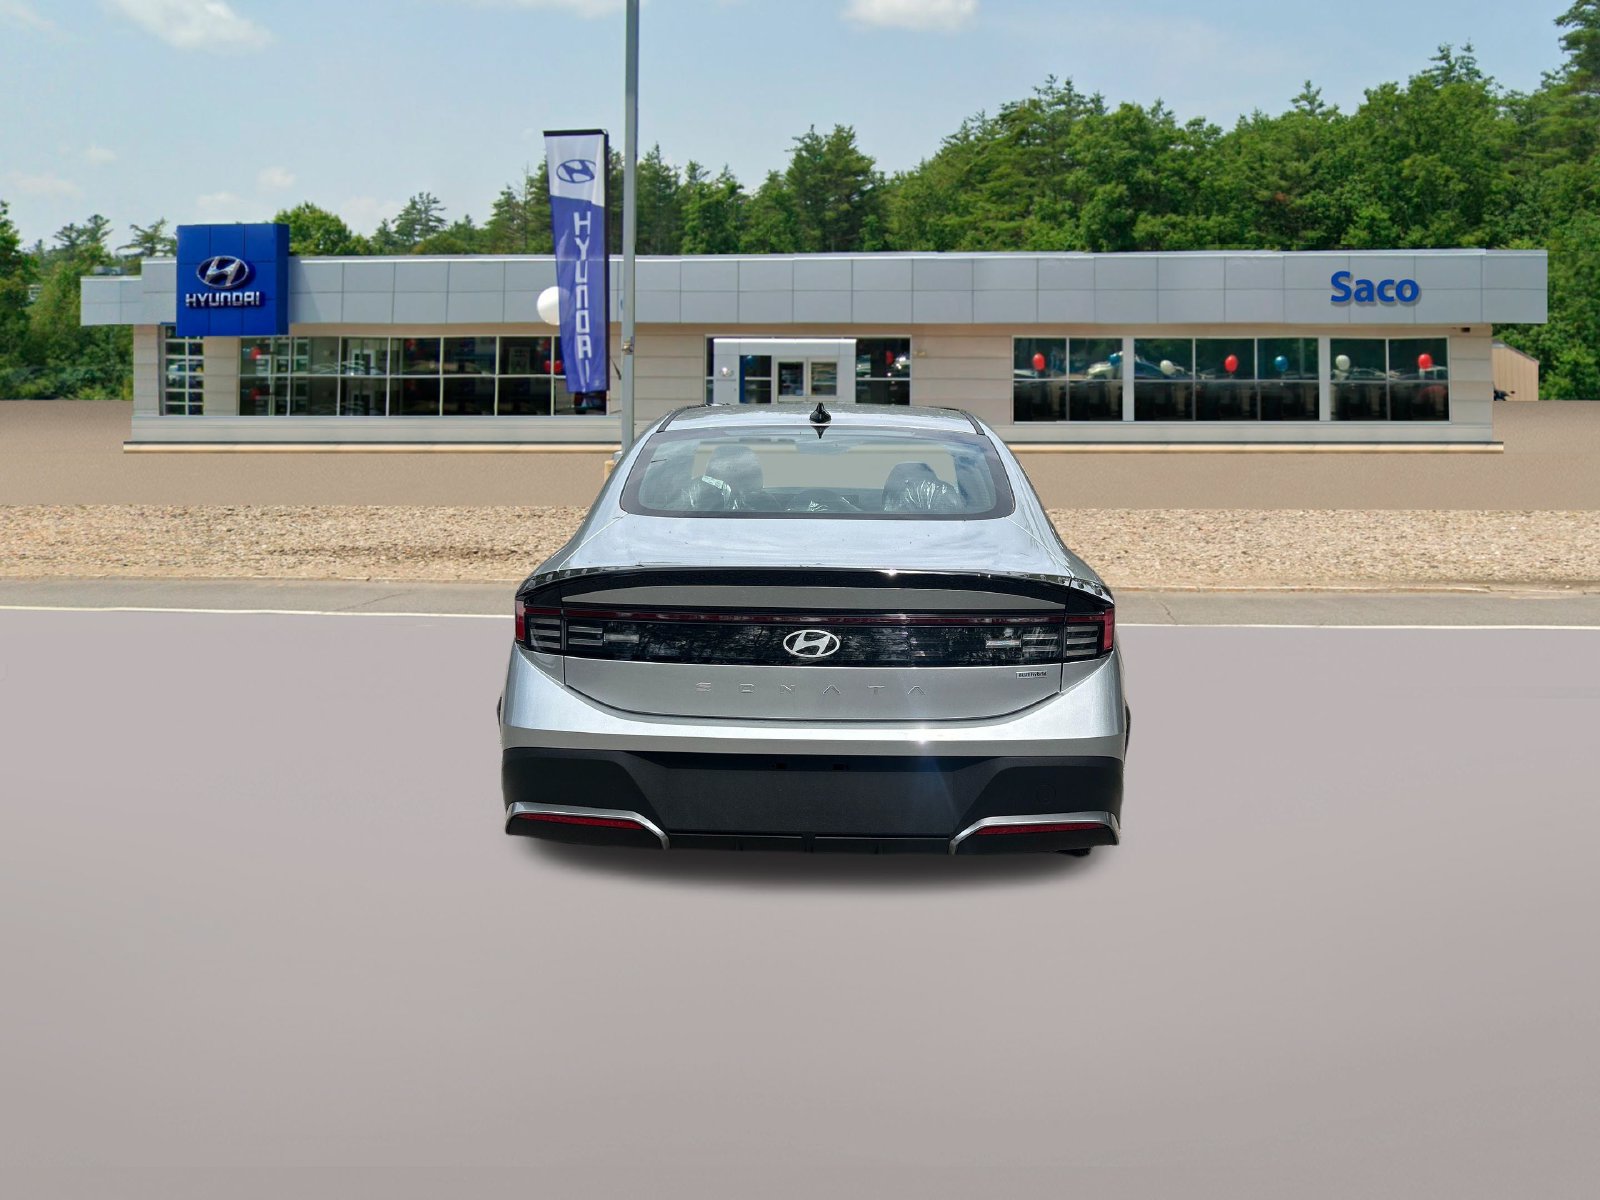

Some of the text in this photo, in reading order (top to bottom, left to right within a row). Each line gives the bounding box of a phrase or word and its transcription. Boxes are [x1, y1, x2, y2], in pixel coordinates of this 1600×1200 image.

[573, 210, 592, 384] HYUNDAI
[1330, 270, 1420, 303] Saco
[185, 291, 261, 307] HYUNDAI
[695, 681, 926, 696] SONATA
